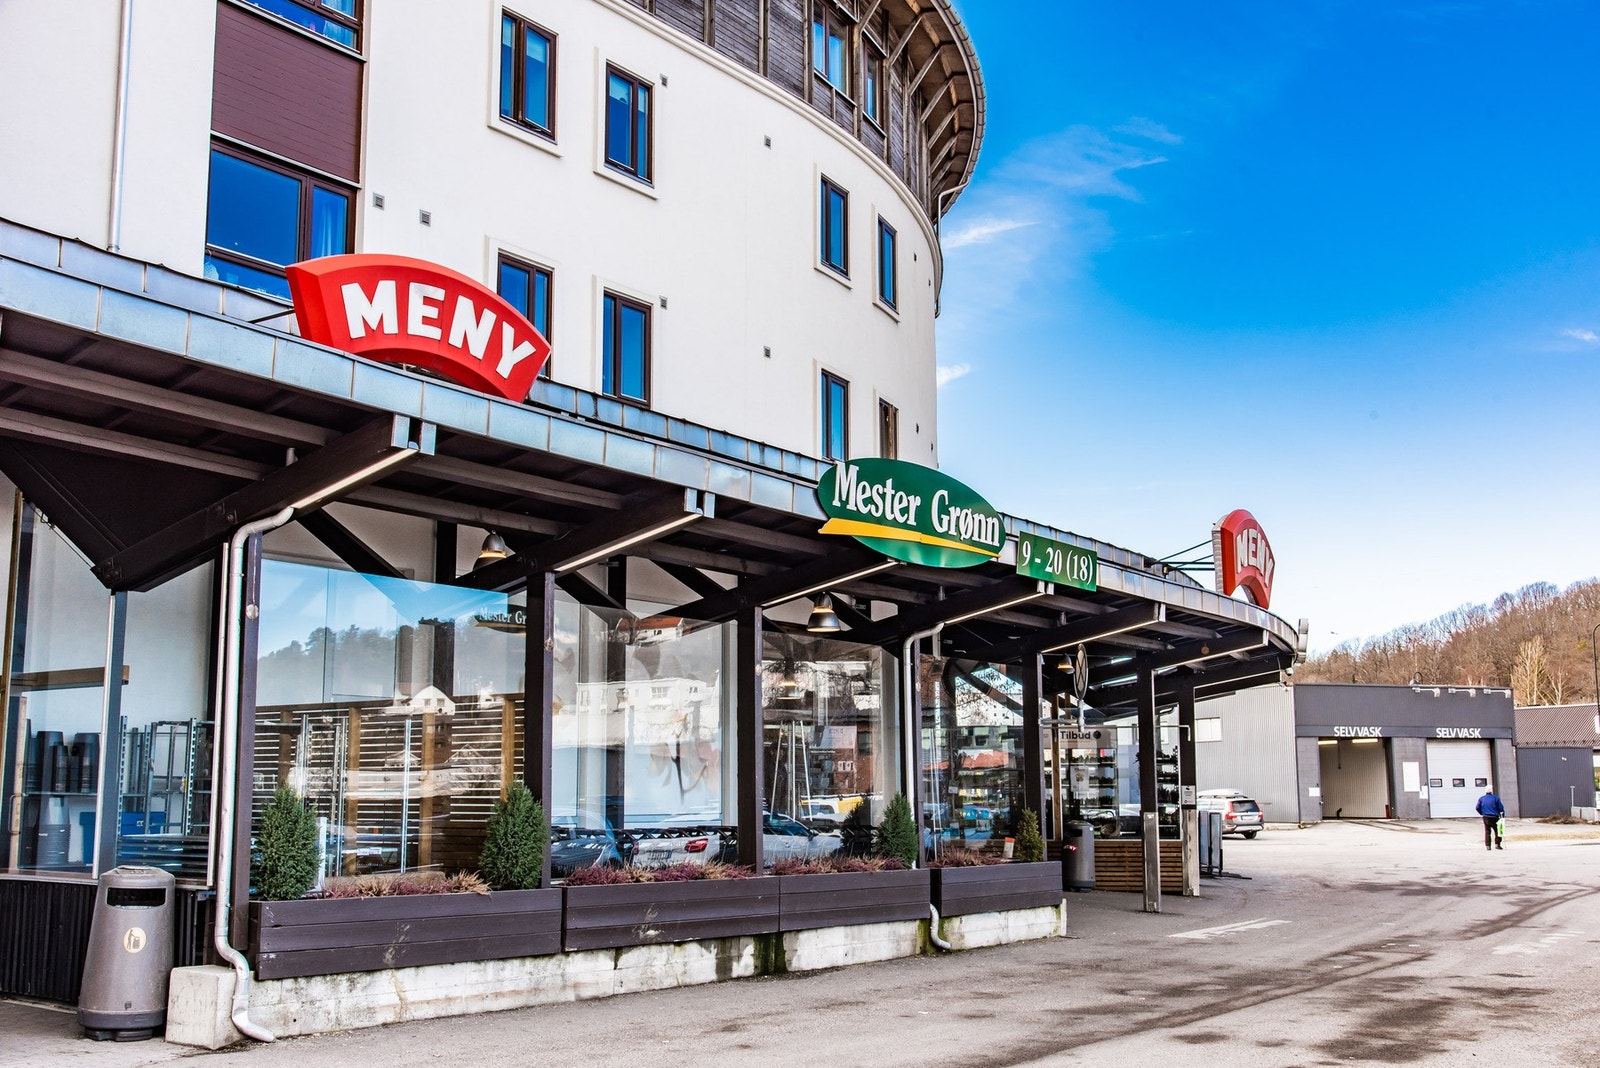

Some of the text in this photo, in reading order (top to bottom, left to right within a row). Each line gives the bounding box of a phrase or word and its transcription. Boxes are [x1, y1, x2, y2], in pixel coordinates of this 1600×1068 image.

[341, 280, 536, 379] MENY
[832, 461, 1000, 546] Mester Grønn
[1022, 540, 1031, 566] 9
[1045, 547, 1061, 575] 20
[1066, 550, 1093, 585] (18)
[1236, 528, 1274, 588] MENY
[515, 610, 527, 624] Gr
[1060, 730, 1091, 740] Tilbud
